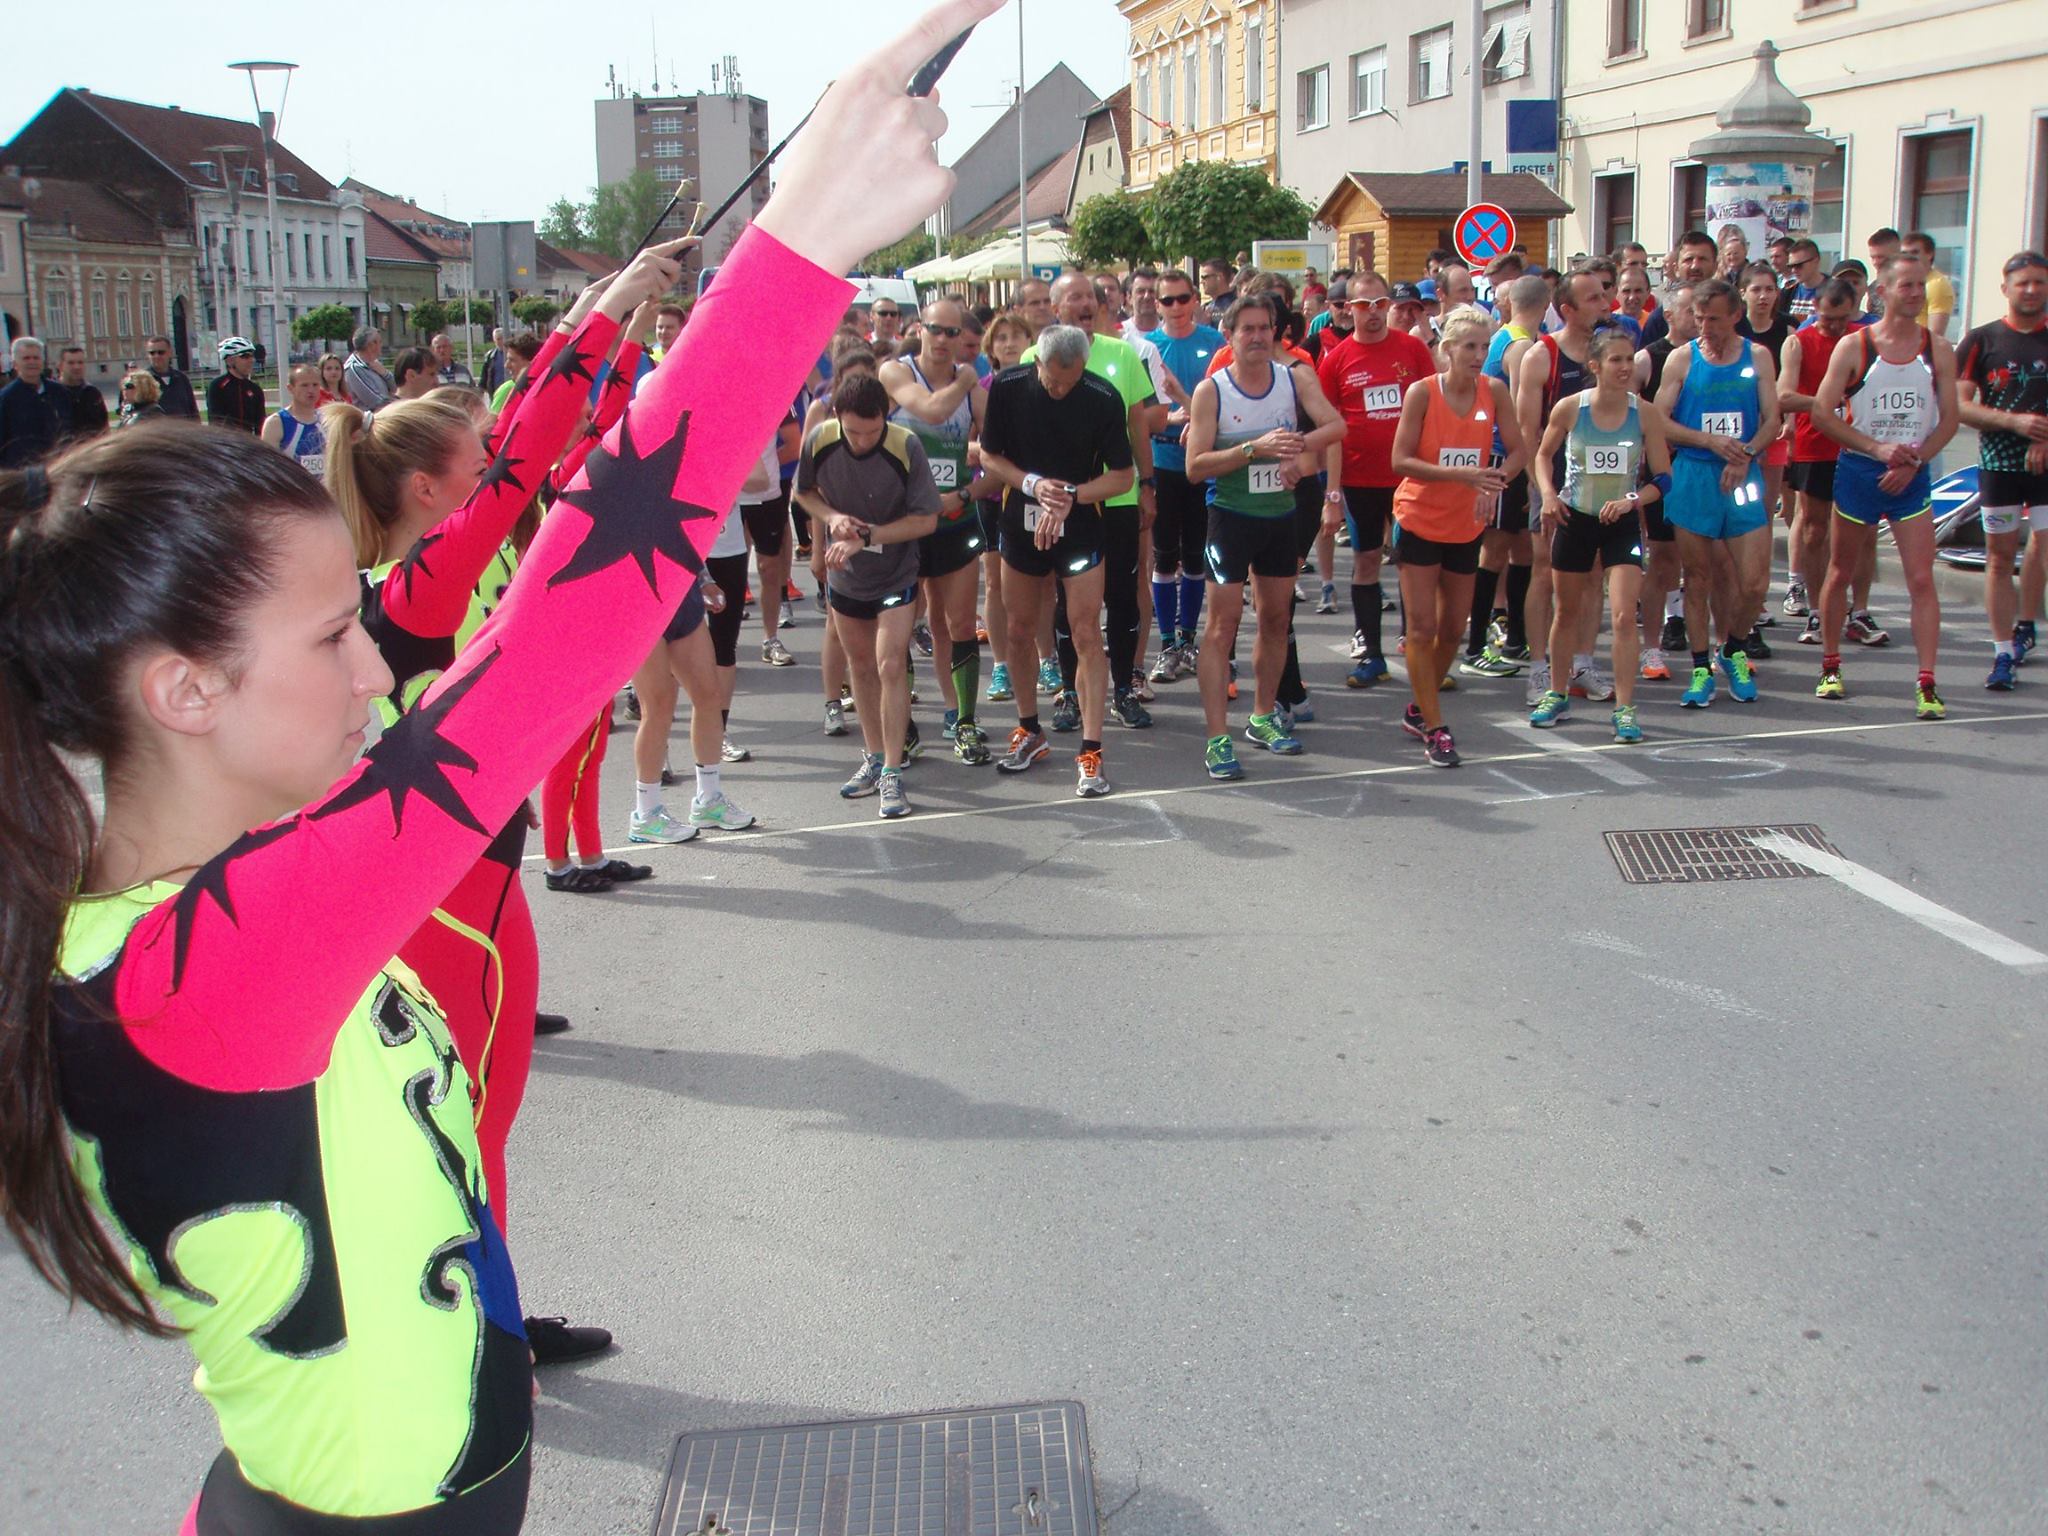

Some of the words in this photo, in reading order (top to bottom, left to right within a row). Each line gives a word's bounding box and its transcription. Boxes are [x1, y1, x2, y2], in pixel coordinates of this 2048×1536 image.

[1512, 164, 1546, 175] ERSTE
[1367, 388, 1398, 406] 110
[1879, 391, 1915, 410] 105
[1442, 452, 1478, 467] 106
[1593, 450, 1619, 469] 99
[931, 464, 954, 482] 22
[1253, 469, 1282, 488] 119
